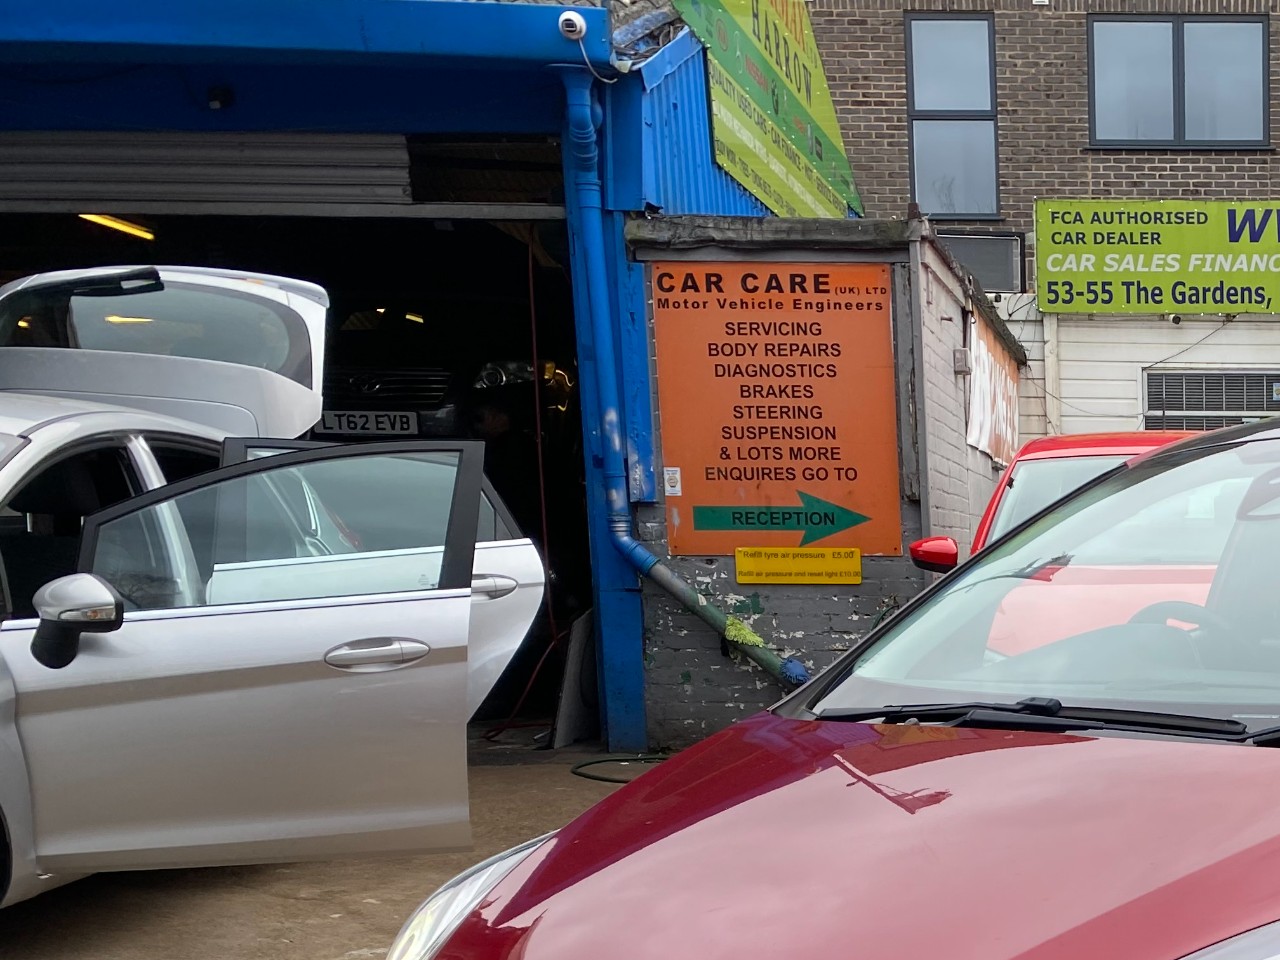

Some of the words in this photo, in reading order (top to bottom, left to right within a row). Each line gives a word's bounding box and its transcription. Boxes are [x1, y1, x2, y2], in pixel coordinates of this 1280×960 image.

[1051, 211, 1084, 224] FCA
[1090, 211, 1208, 225] AUTHORISED
[1051, 231, 1086, 245] CAR
[1093, 231, 1162, 245] DEALER
[1046, 253, 1095, 272] CAR
[1103, 253, 1181, 272] SALES
[657, 272, 724, 293] CAR
[741, 273, 830, 294] CARE
[834, 286, 860, 296] (UK)
[866, 286, 887, 295] LTD
[1047, 280, 1114, 304] 53-55
[1121, 280, 1163, 304] The
[1171, 280, 1272, 309] Gardens,
[657, 298, 708, 309] Motor
[716, 298, 784, 310] Vehicle
[792, 299, 883, 313] Engineers
[725, 321, 822, 336] SERVICING
[708, 343, 758, 357] BODY
[764, 343, 841, 357] REPAIRS
[714, 364, 837, 378] DIAGNOSTICS
[740, 384, 814, 399] BRAKES
[733, 405, 822, 420] STEERING
[322, 413, 370, 431] LT62
[374, 413, 410, 431] EVB
[721, 426, 836, 440] SUSPENSION
[719, 446, 731, 460] &
[737, 446, 783, 460] LOTS
[789, 446, 841, 460] MORE
[705, 467, 796, 481] ENQUIRES
[802, 467, 828, 481] GO
[834, 467, 858, 481] TO
[732, 511, 835, 526] RECEPTION
[764, 551, 779, 560] tyre
[792, 552, 825, 560] pressure
